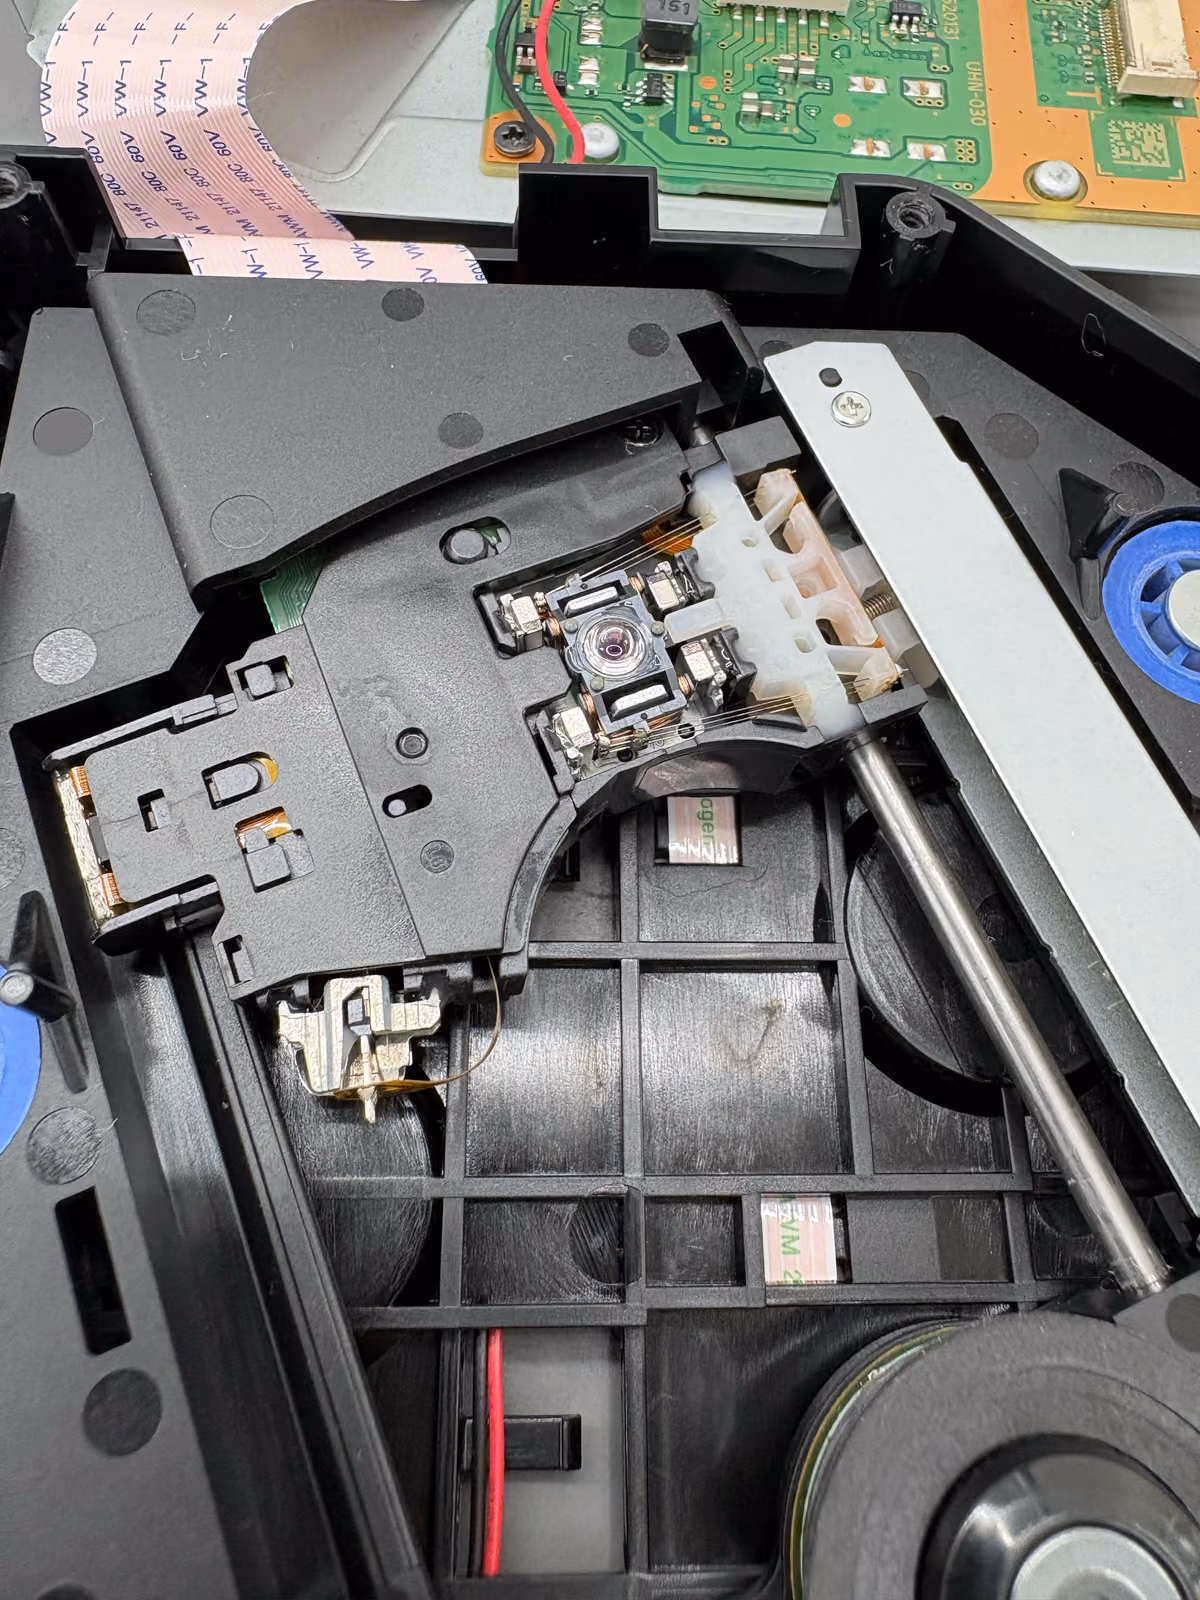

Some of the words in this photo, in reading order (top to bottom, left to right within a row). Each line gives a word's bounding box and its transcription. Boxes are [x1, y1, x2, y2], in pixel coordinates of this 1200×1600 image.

[40, 61, 56, 117] VW-1
[77, 60, 93, 118] VW-1
[114, 60, 132, 118] VW-1
[153, 59, 172, 118] VW-1
[194, 58, 213, 118] VW-1
[81, 130, 104, 164] 60V
[120, 130, 146, 164] 60V
[160, 130, 188, 161] 60V
[203, 128, 232, 157] 60V
[100, 172, 127, 197] 80C
[141, 170, 169, 193] 80C
[183, 167, 211, 188] 80C
[293, 242, 324, 280] VW-1
[350, 243, 375, 270] VW-
[416, 267, 437, 284] 0V
